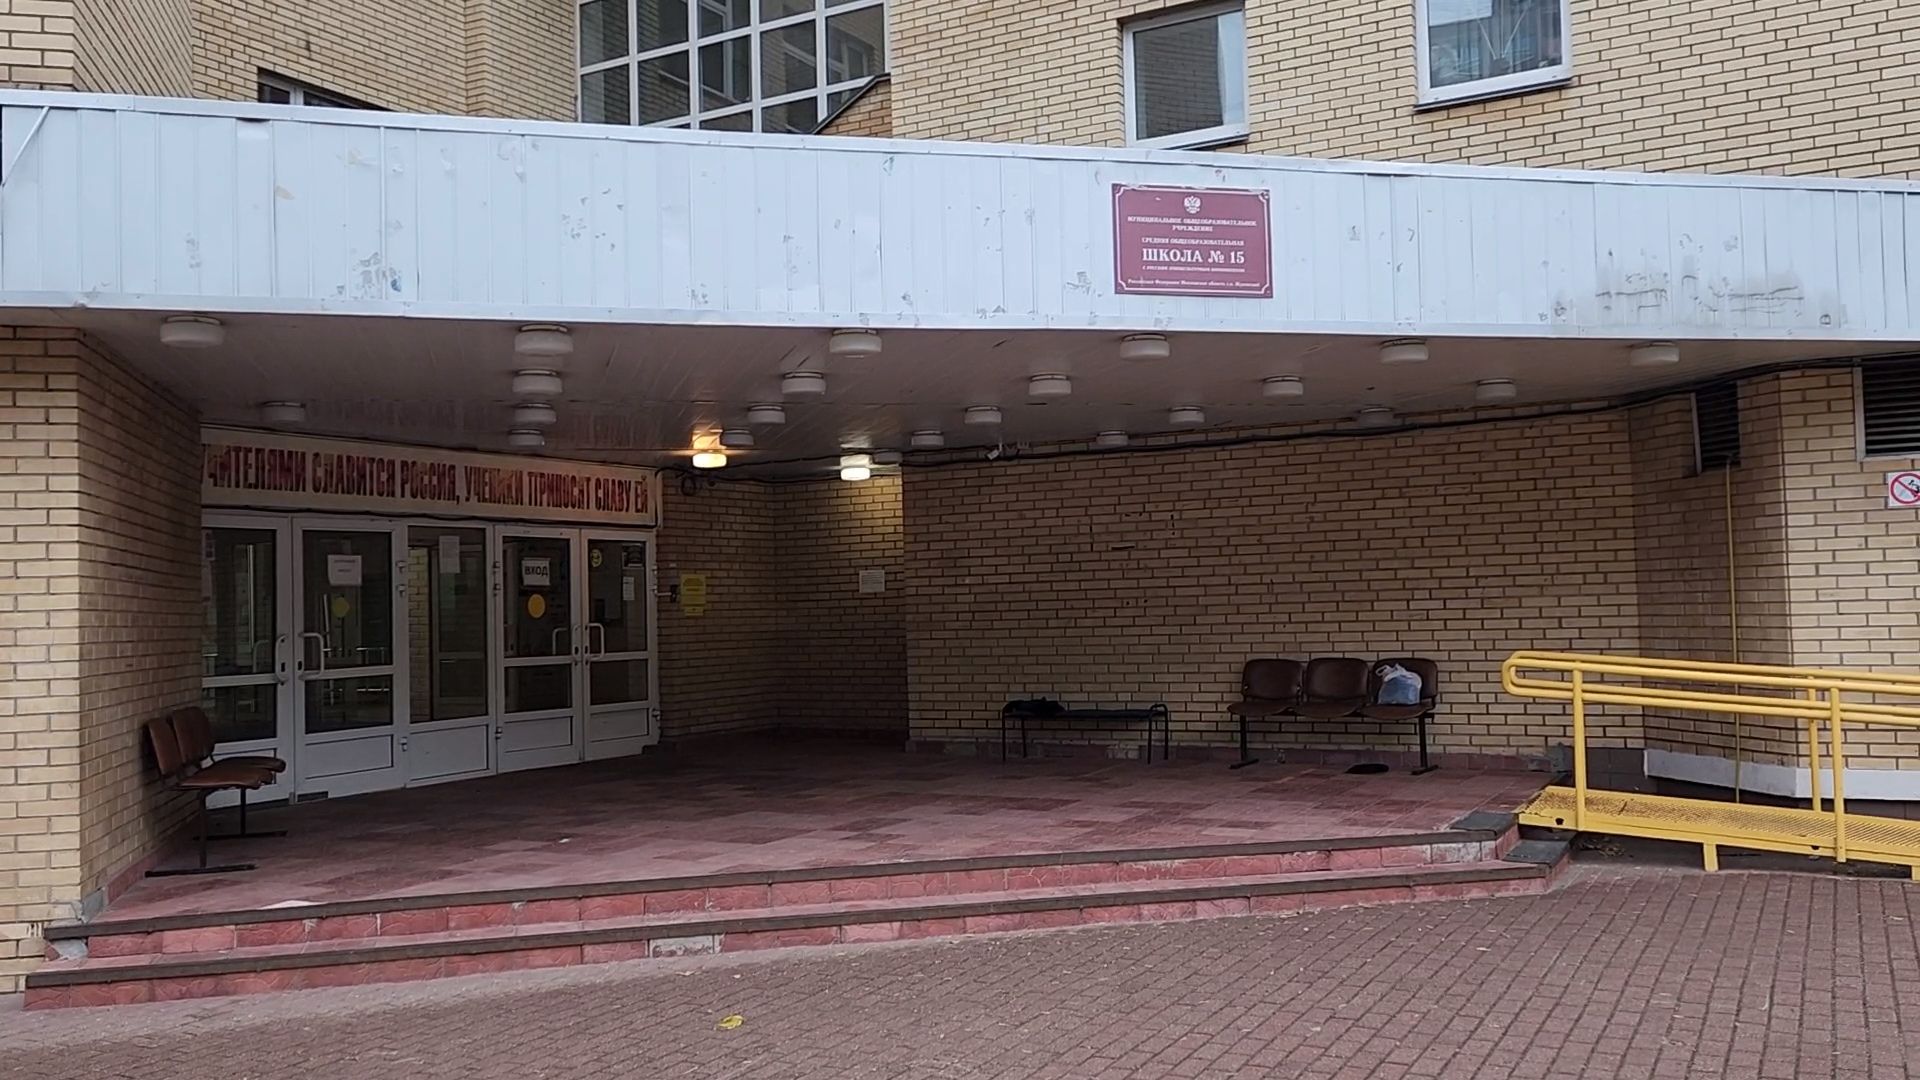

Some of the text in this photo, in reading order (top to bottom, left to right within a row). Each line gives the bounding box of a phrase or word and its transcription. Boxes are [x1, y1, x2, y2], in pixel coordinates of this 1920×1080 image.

[1142, 248, 1245, 264] ШКОЛА № 15
[201, 443, 306, 492] ЧИТЕЛЯМИ
[312, 452, 396, 498] СЛАВИТСЯ
[401, 460, 460, 505] РОССИЯ,
[595, 477, 631, 512] СЛАВУ
[634, 475, 648, 513] ЕЙ
[524, 565, 548, 577] ВХОД
